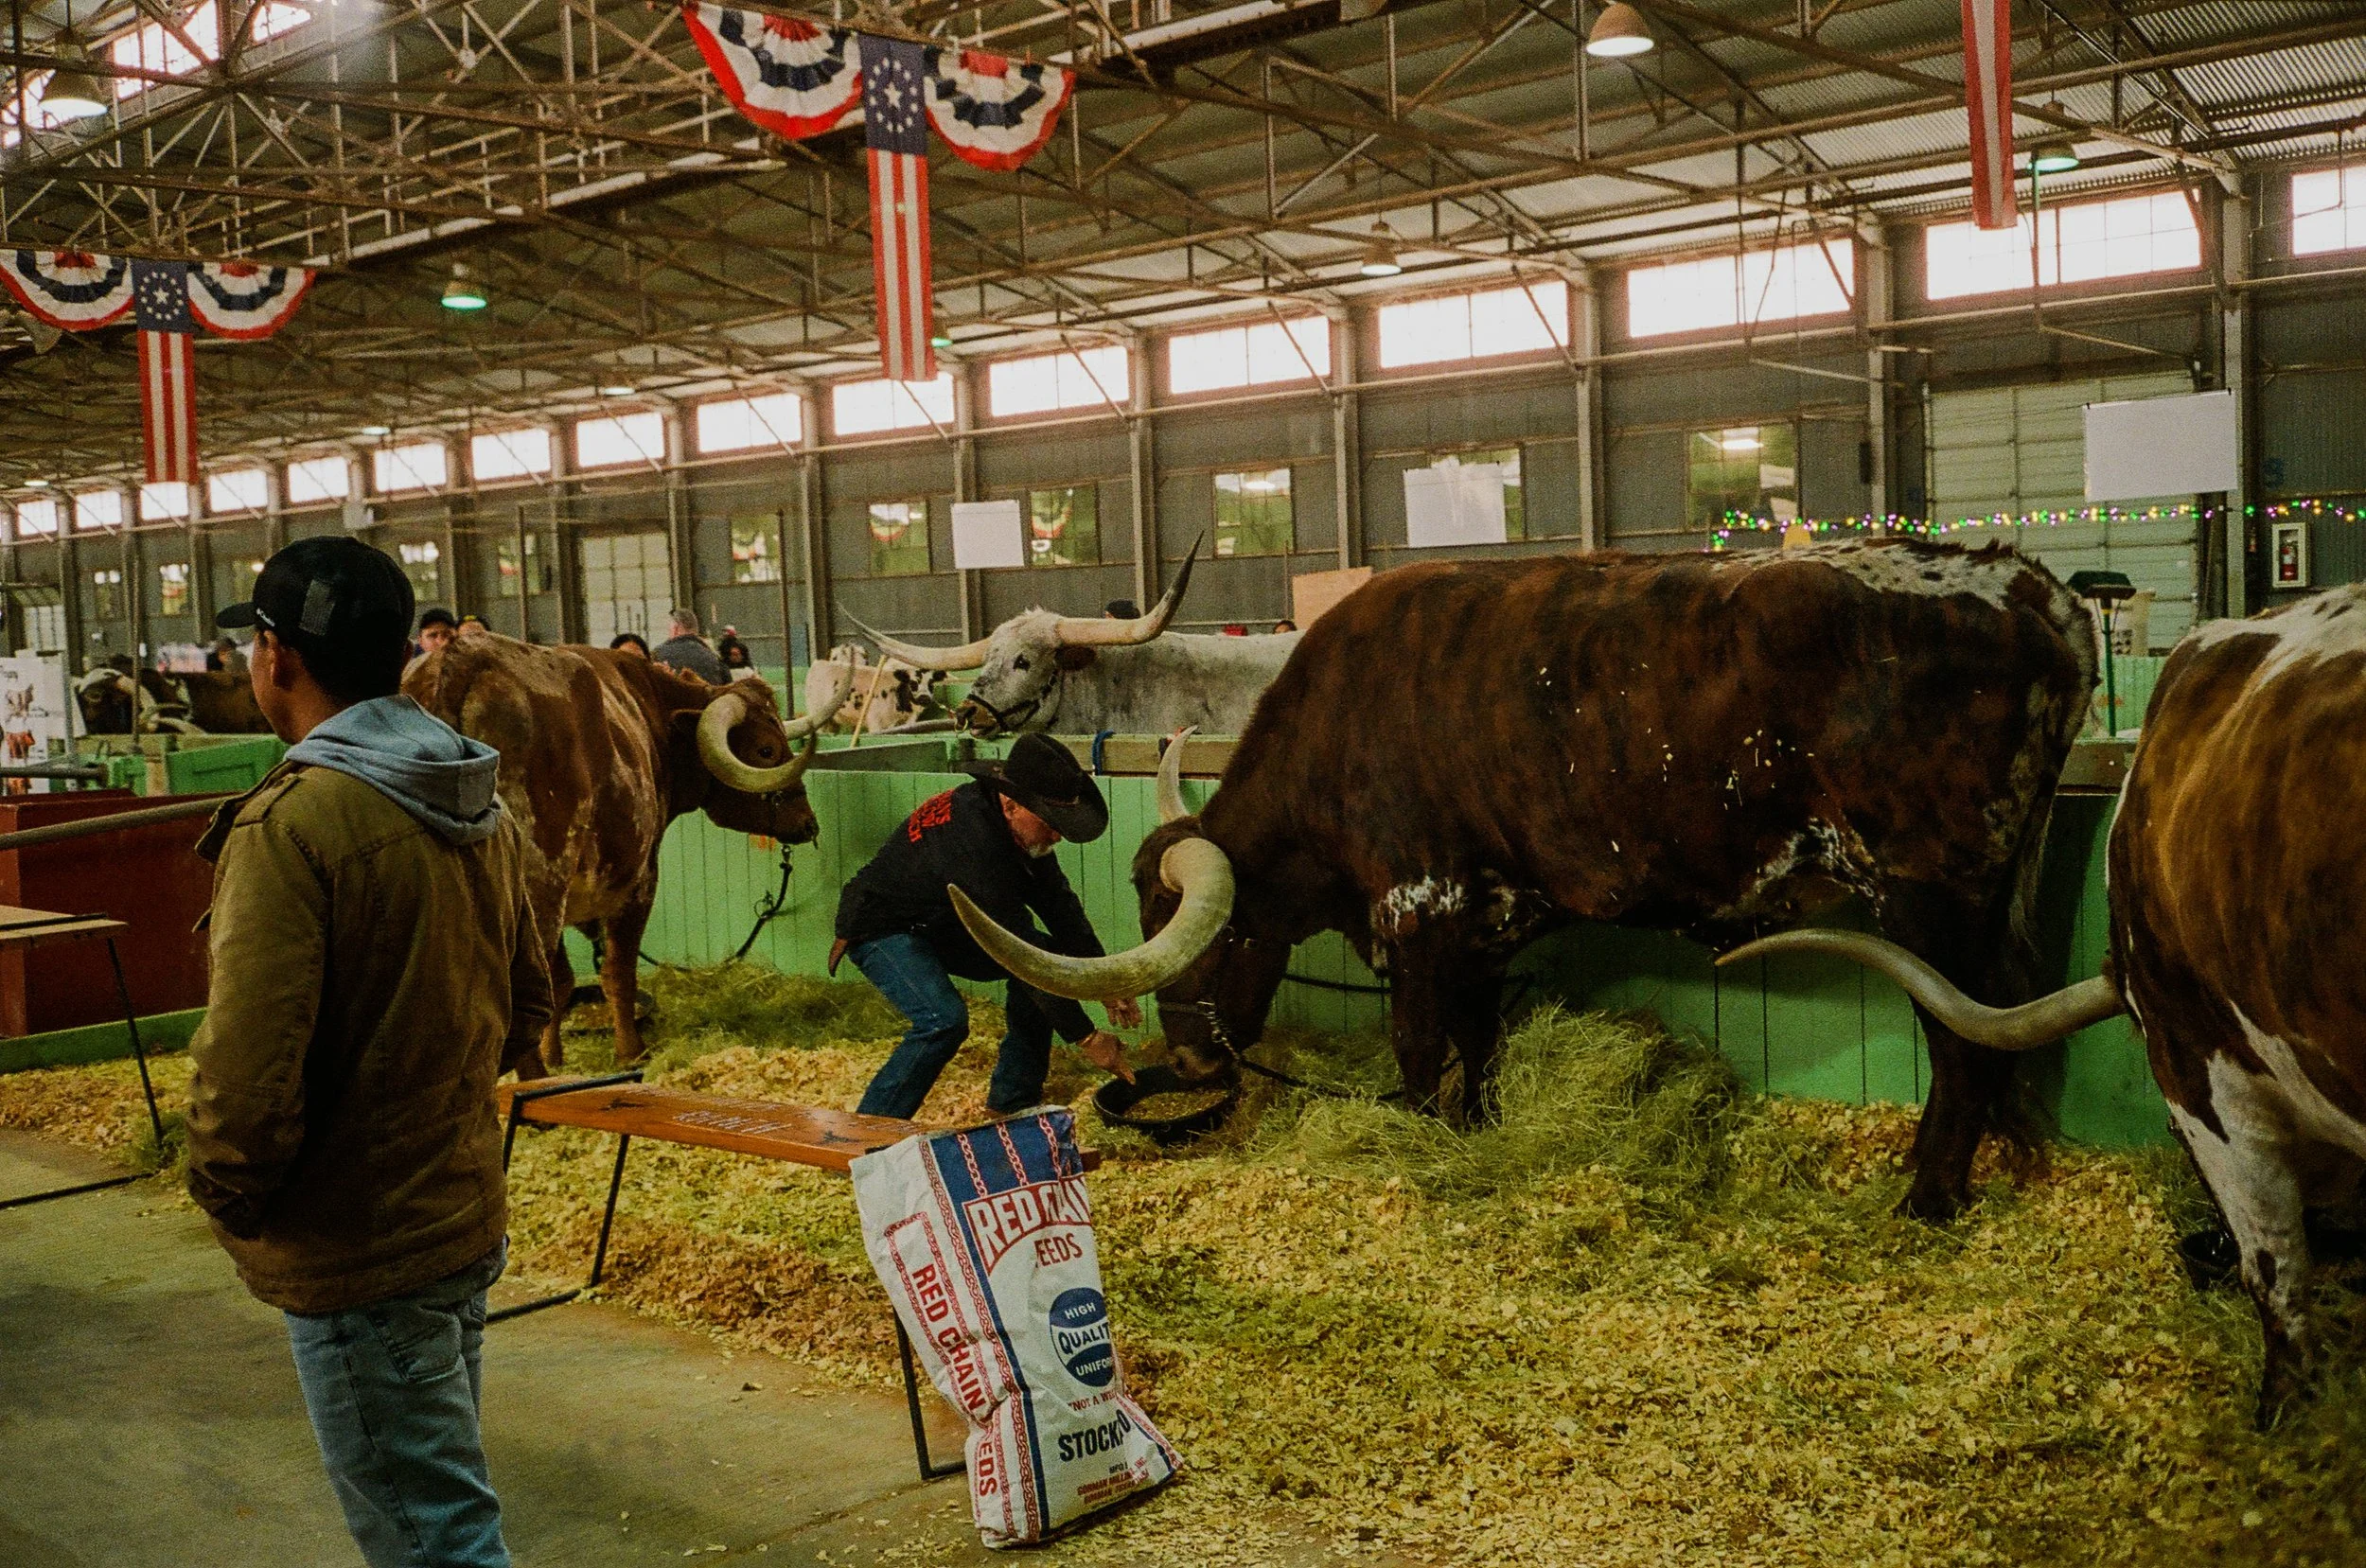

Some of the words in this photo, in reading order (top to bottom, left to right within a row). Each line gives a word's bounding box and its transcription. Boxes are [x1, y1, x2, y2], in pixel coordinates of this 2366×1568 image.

[967, 1189, 1042, 1269] RED
[1064, 1302, 1096, 1320] HIGH
[911, 1263, 949, 1322] RED
[938, 1327, 987, 1411] CHAIN
[1058, 1322, 1110, 1355] QUALIT
[1075, 1357, 1113, 1377] UNIFO
[1092, 1395, 1100, 1405] A
